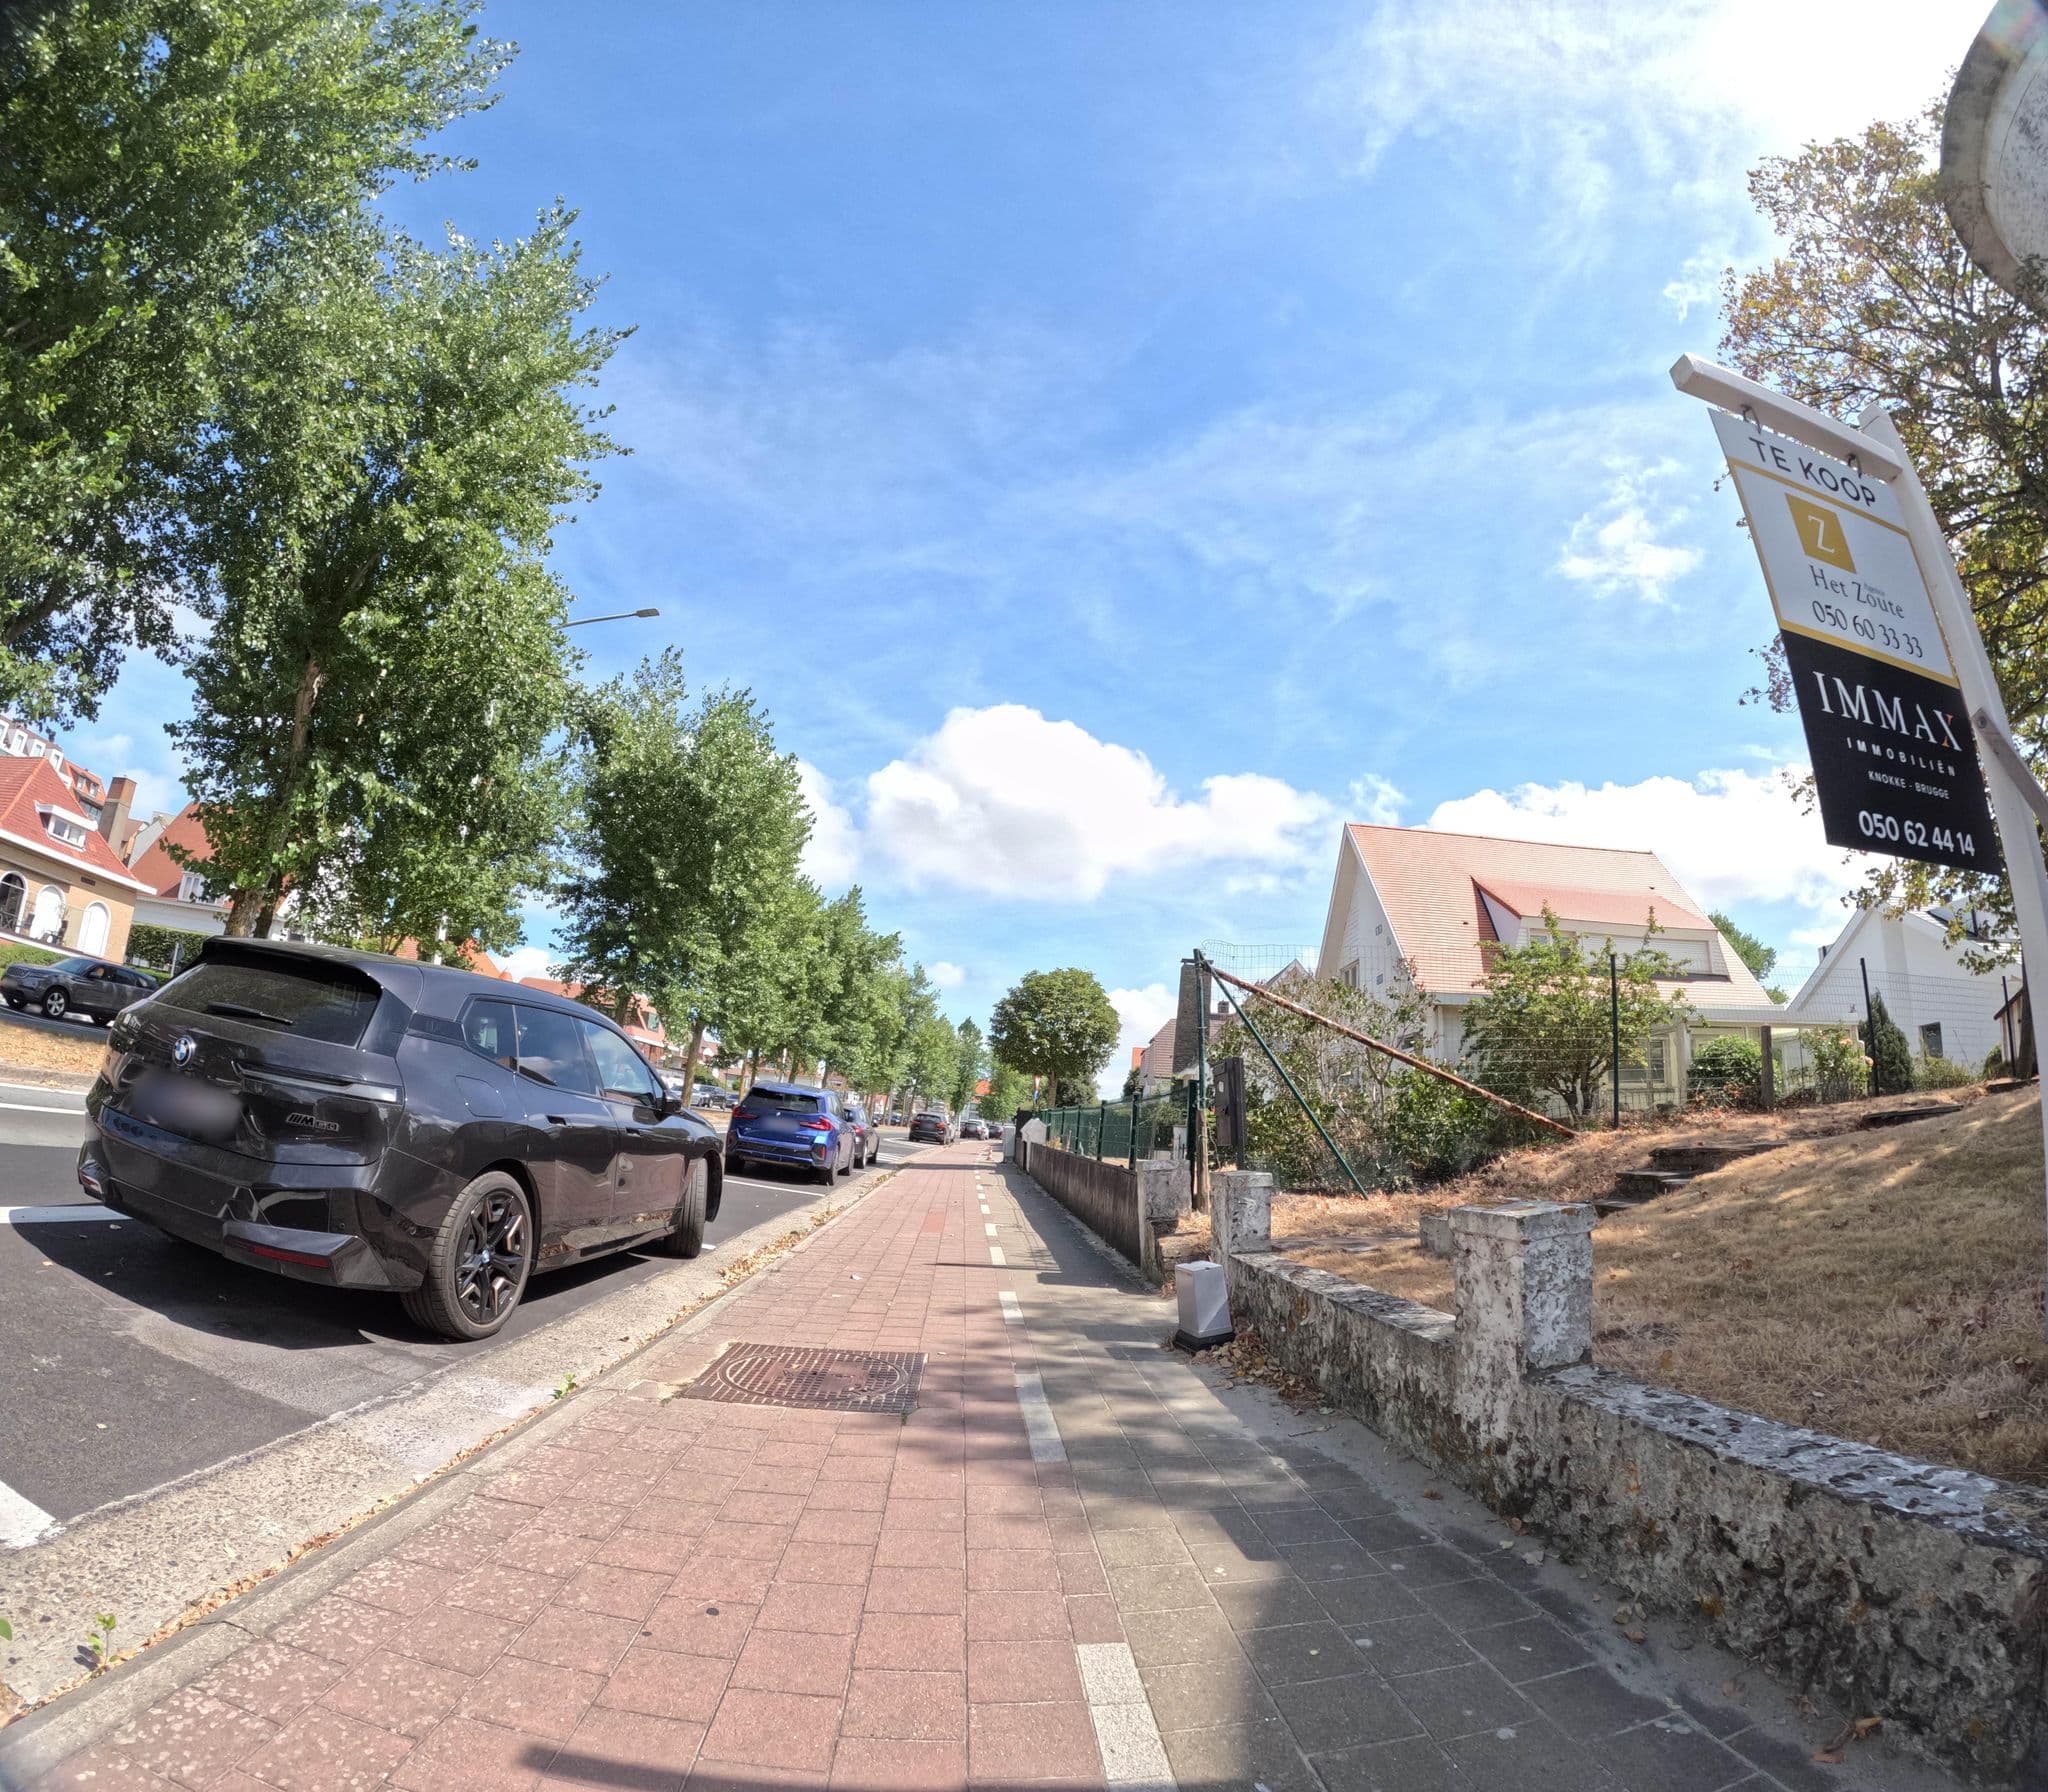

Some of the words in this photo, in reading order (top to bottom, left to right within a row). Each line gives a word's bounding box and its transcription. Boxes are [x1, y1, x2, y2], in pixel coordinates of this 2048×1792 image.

[1749, 437, 1791, 472] TE
[1799, 458, 1876, 507] KOOP
[1808, 515, 1835, 553] Z
[1810, 565, 1848, 597] Het
[1852, 581, 1904, 618] Zoute
[1812, 600, 1848, 630] 050
[1853, 615, 1875, 640] 60
[1878, 624, 1900, 649] 33
[1902, 633, 1922, 658] 33
[1812, 671, 1962, 751] IMMAX
[1846, 737, 1956, 777] IMMOBILIËN
[1868, 770, 1906, 788] KNOKKE
[1915, 782, 1950, 800] BRUGGE
[1859, 810, 1900, 841] 050
[1904, 820, 1929, 848] 62
[1932, 827, 1954, 852] 44
[1956, 832, 1975, 856] 14
